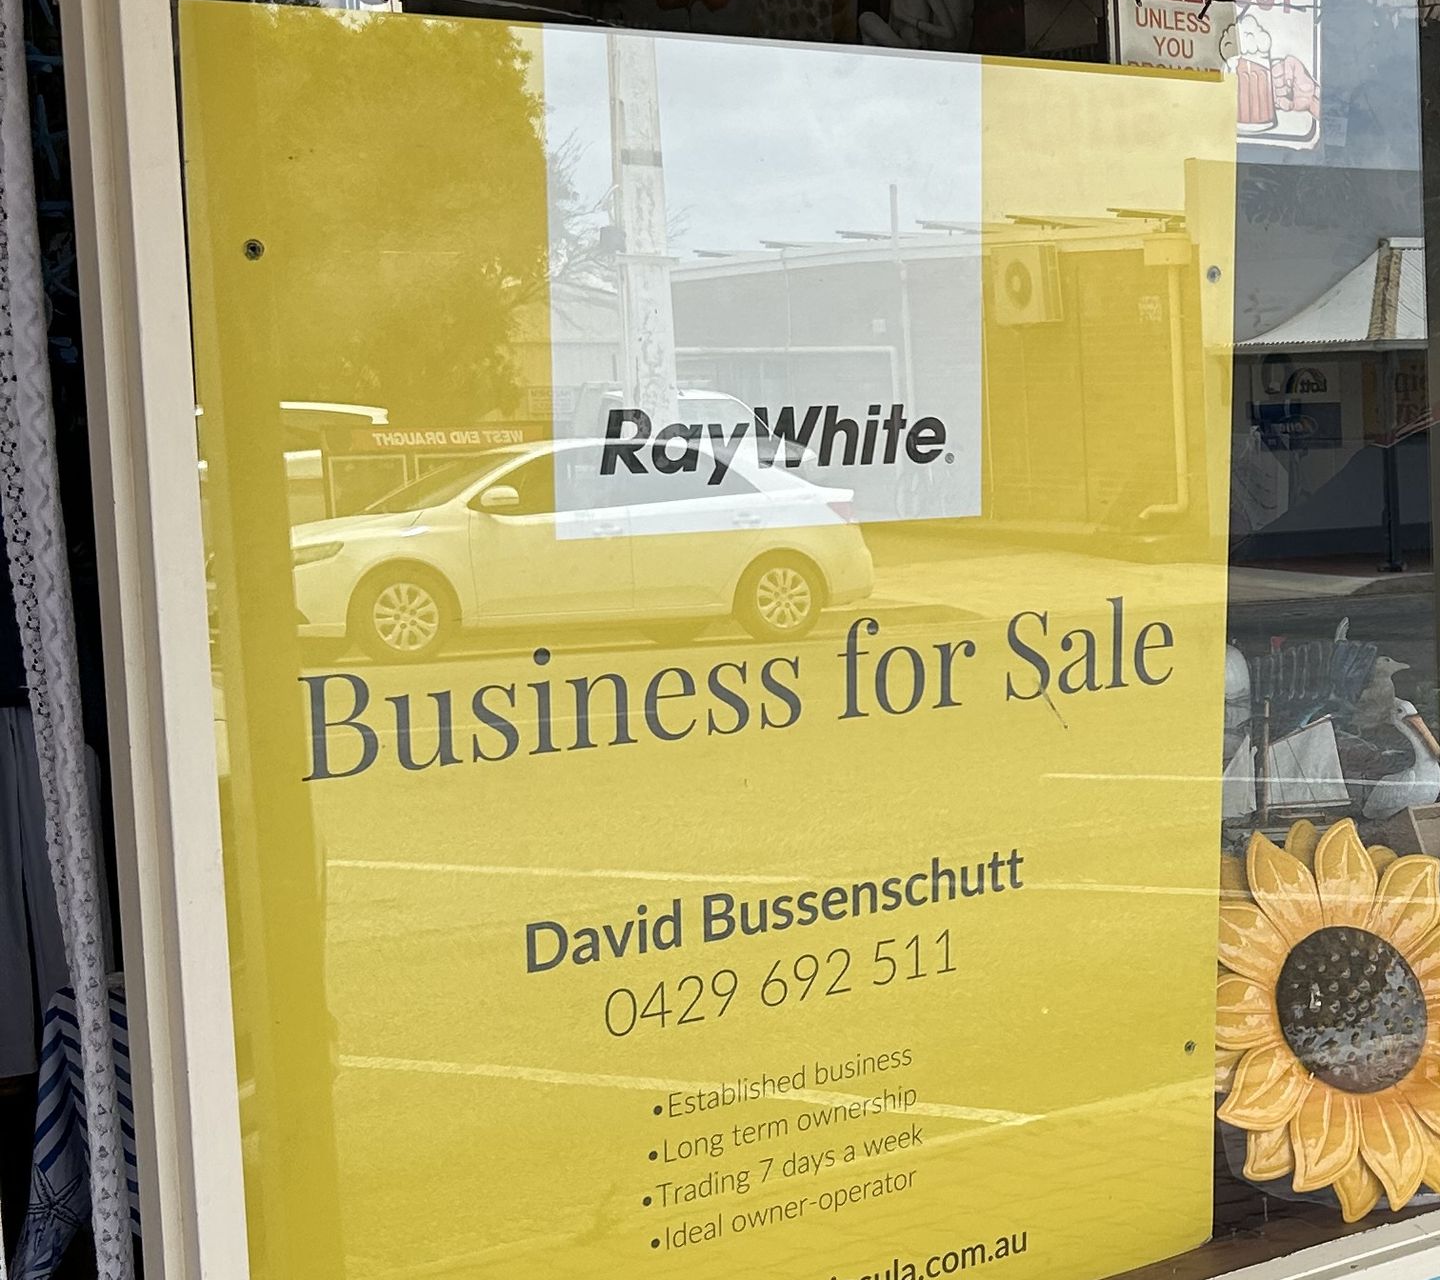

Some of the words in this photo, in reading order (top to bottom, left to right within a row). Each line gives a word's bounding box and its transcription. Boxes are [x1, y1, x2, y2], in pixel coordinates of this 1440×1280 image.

[1136, 7, 1211, 34] UNLESS
[1153, 35, 1194, 59] YOU
[298, 645, 803, 782] Business
[838, 616, 975, 721] for
[1005, 595, 1176, 703] Sale
[524, 899, 683, 974] David
[701, 847, 1025, 944] Bussenschutt
[604, 967, 739, 1038] 0429
[760, 948, 852, 1009] 692
[872, 928, 958, 988] 511
[667, 1065, 807, 1118] Established
[814, 1044, 913, 1090] business
[656, 1166, 750, 1208] Trading
[760, 1158, 775, 1185] 7
[781, 1144, 836, 1182] days
[843, 1143, 857, 1163] a
[863, 1123, 924, 1158] week
[662, 1133, 724, 1169] Long
[731, 1116, 790, 1150] term
[796, 1084, 918, 1135] ownership
[665, 1214, 724, 1251] Ideal
[730, 1165, 918, 1234] owner-operator
